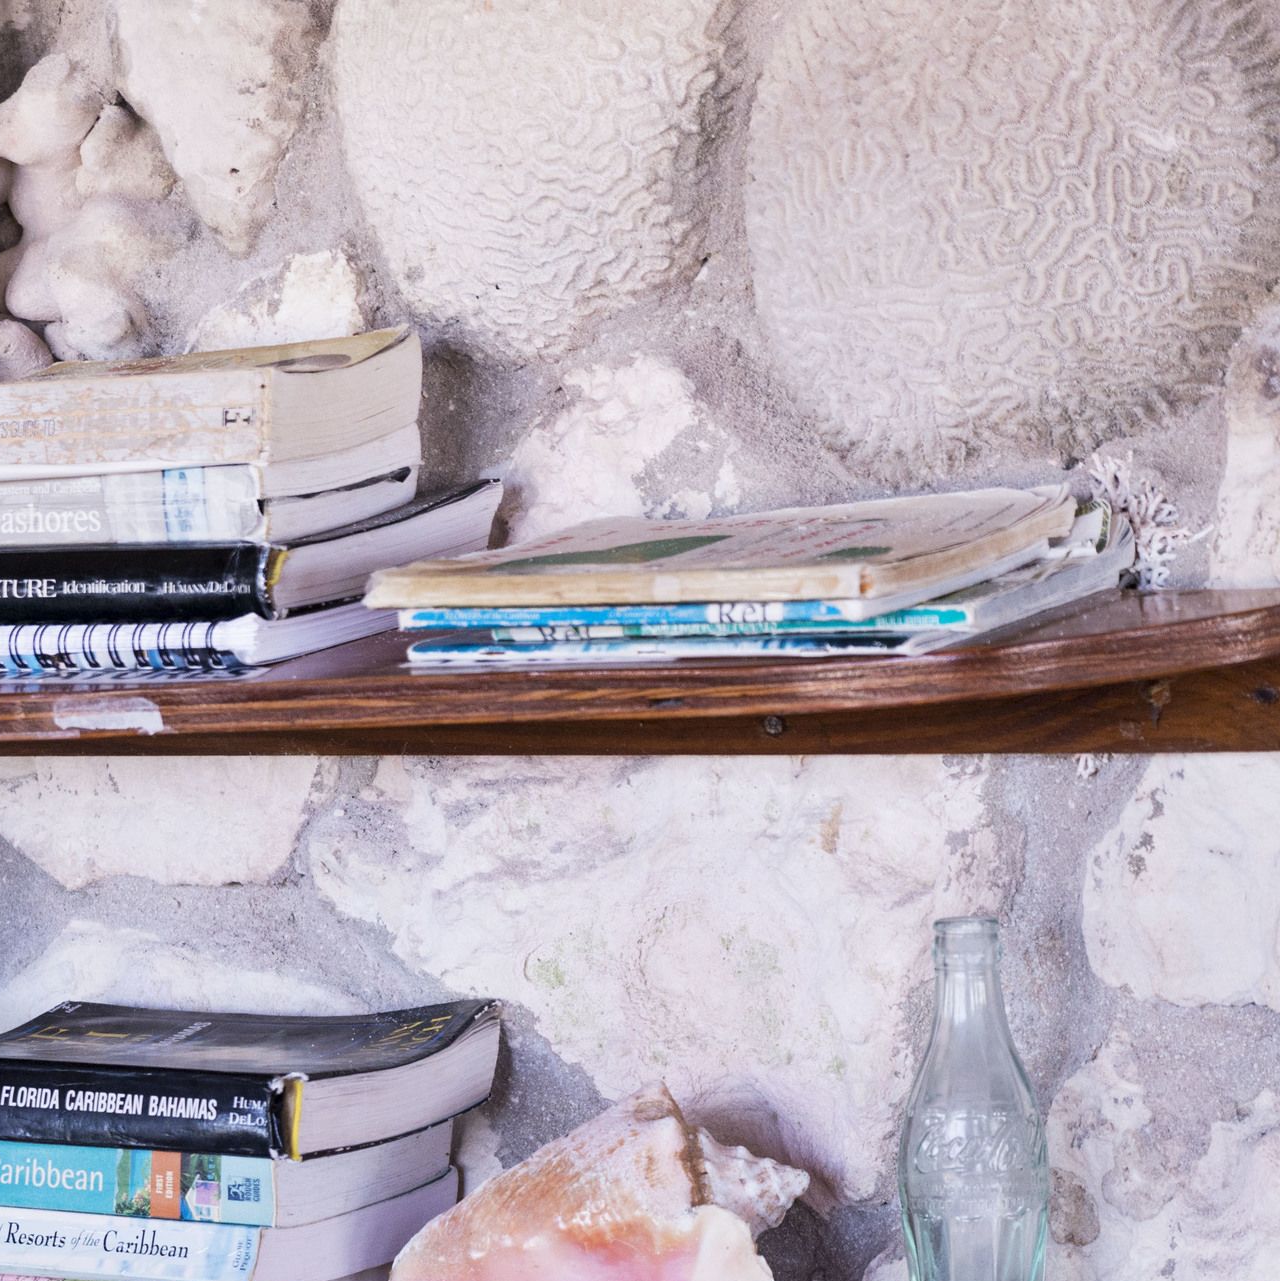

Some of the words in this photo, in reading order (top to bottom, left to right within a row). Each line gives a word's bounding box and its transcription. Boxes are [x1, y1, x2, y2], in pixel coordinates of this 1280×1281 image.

[63, 580, 144, 595] Identification
[0, 1086, 60, 1110] FLORIDA
[65, 1090, 143, 1115] CARIBBEAN
[149, 1095, 217, 1121] BAHAMAS
[155, 1174, 163, 1194] FIRST
[165, 1170, 173, 1199] EDITION
[6, 1221, 66, 1249] Resorts
[70, 1232, 82, 1249] of
[83, 1231, 100, 1247] the
[103, 1229, 189, 1259] Caribbean
